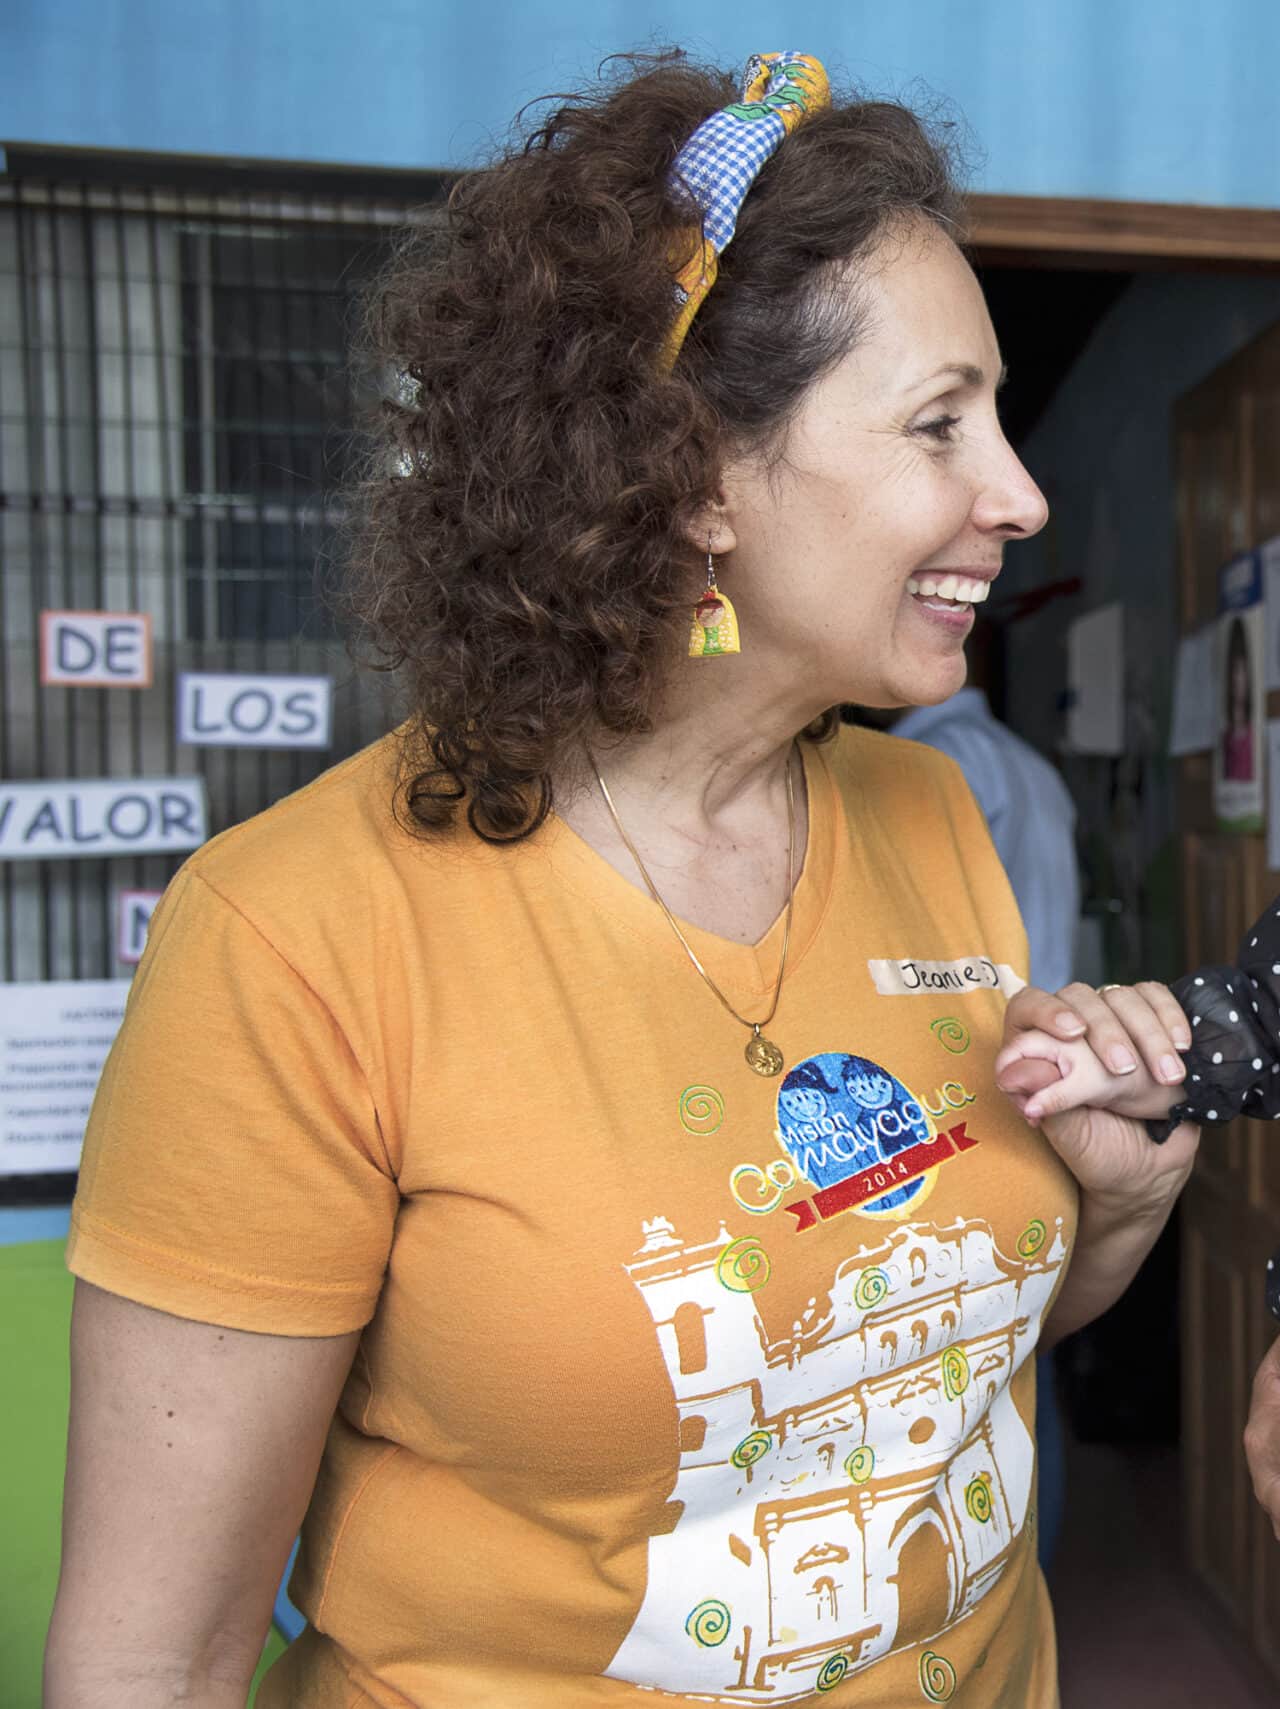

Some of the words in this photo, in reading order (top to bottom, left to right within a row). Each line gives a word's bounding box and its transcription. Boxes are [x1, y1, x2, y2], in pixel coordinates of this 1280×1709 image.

[57, 624, 138, 676] DE
[191, 686, 318, 736] LOS
[729, 1081, 977, 1216] Comayagua
[863, 1162, 909, 1193] 2014
